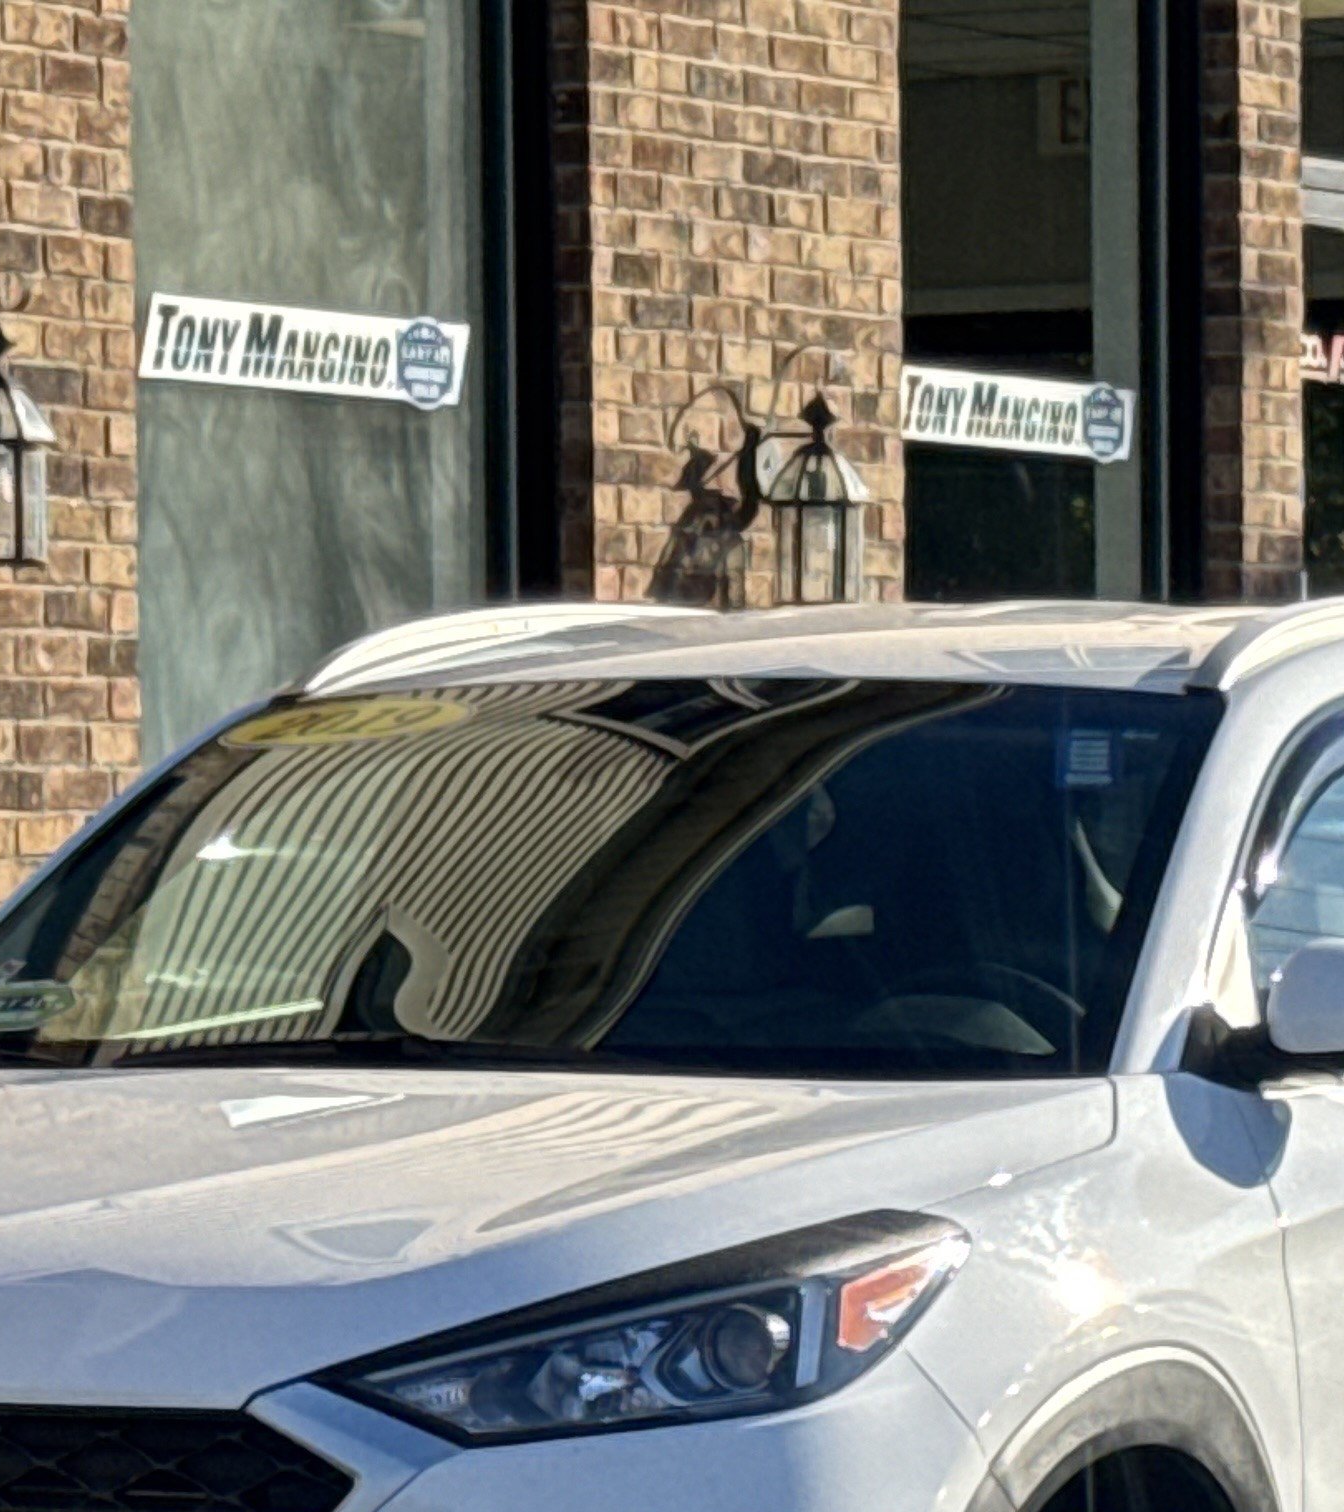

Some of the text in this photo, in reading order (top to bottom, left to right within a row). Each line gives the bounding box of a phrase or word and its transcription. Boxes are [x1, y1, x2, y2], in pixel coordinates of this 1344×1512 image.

[153, 304, 241, 375] TONY
[904, 375, 966, 436] TONY
[251, 704, 443, 740] 2019
